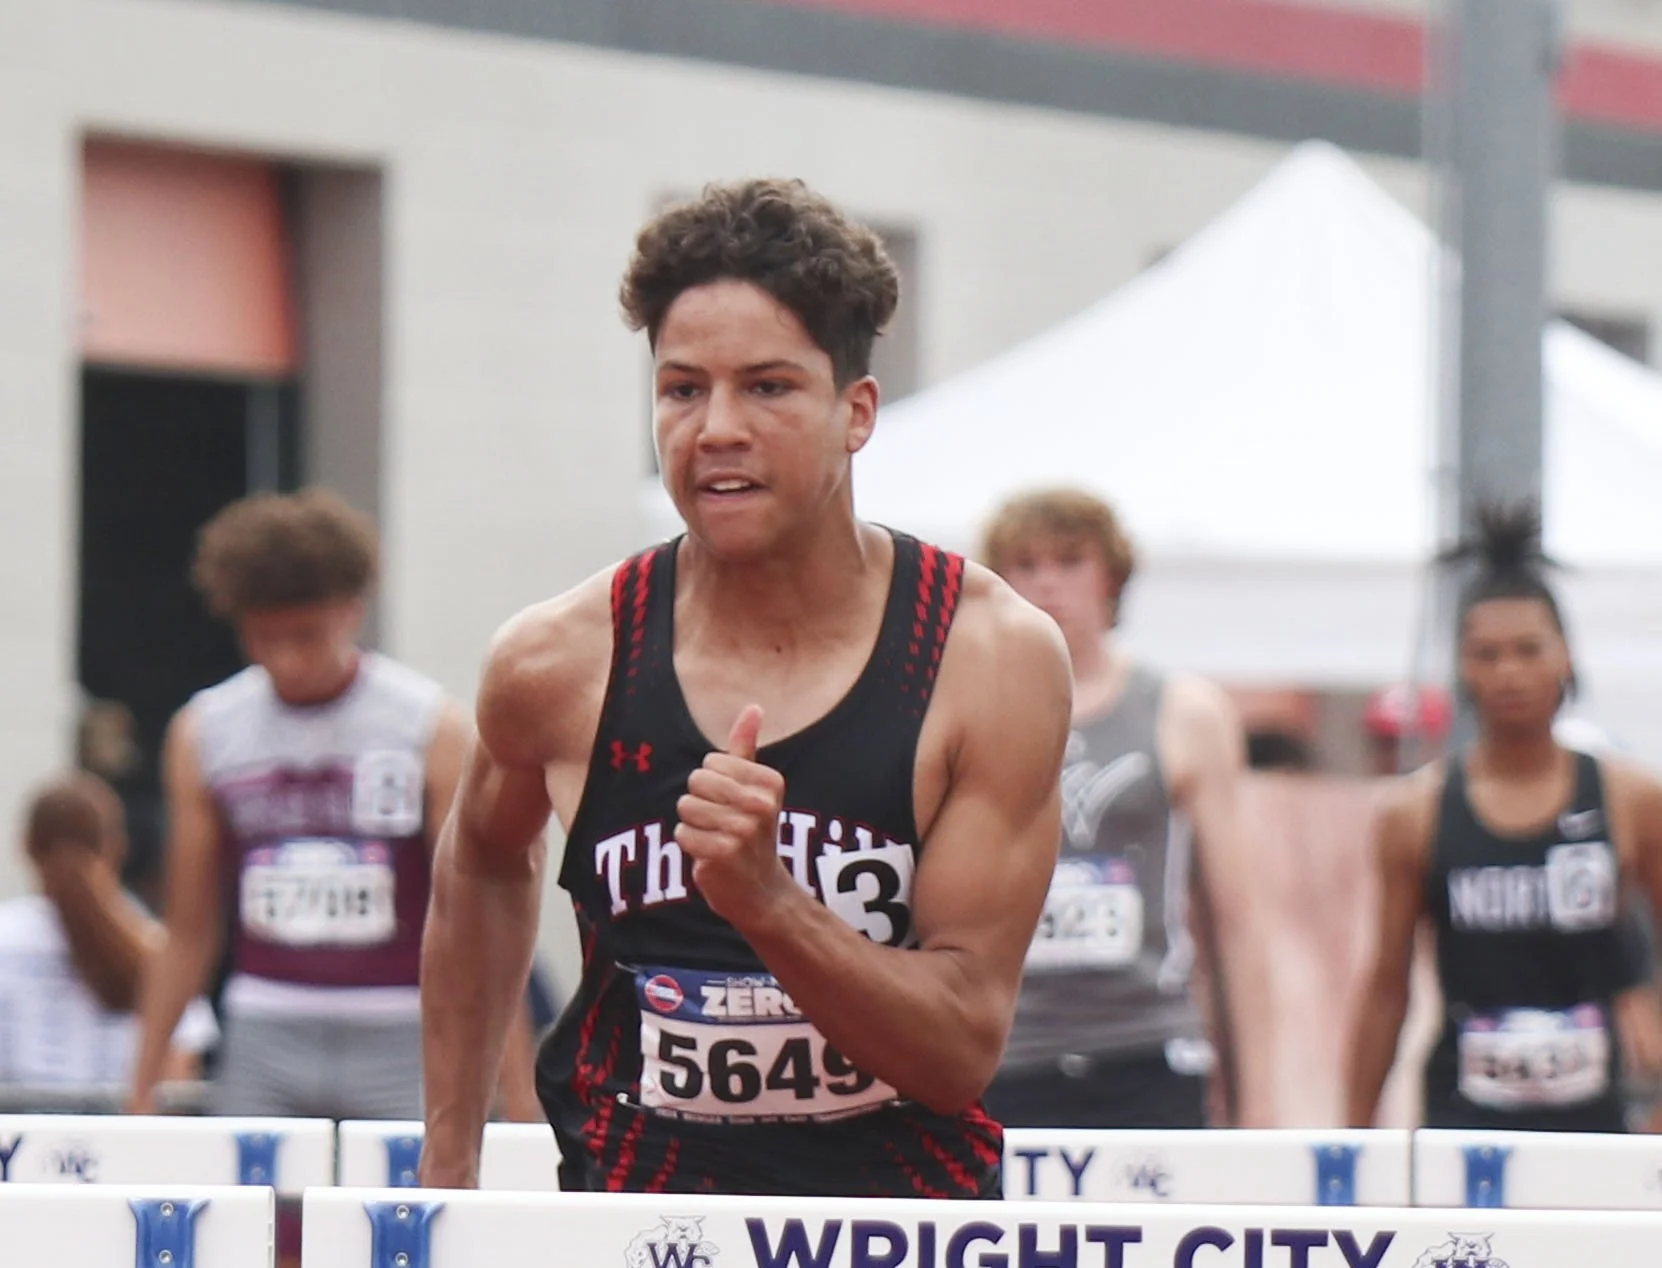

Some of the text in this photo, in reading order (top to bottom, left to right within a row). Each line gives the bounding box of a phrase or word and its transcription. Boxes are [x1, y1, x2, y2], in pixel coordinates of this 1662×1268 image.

[594, 821, 688, 916] Th
[836, 858, 912, 948] 3
[657, 1029, 878, 1103] 5649
[1013, 1148, 1096, 1197] TY
